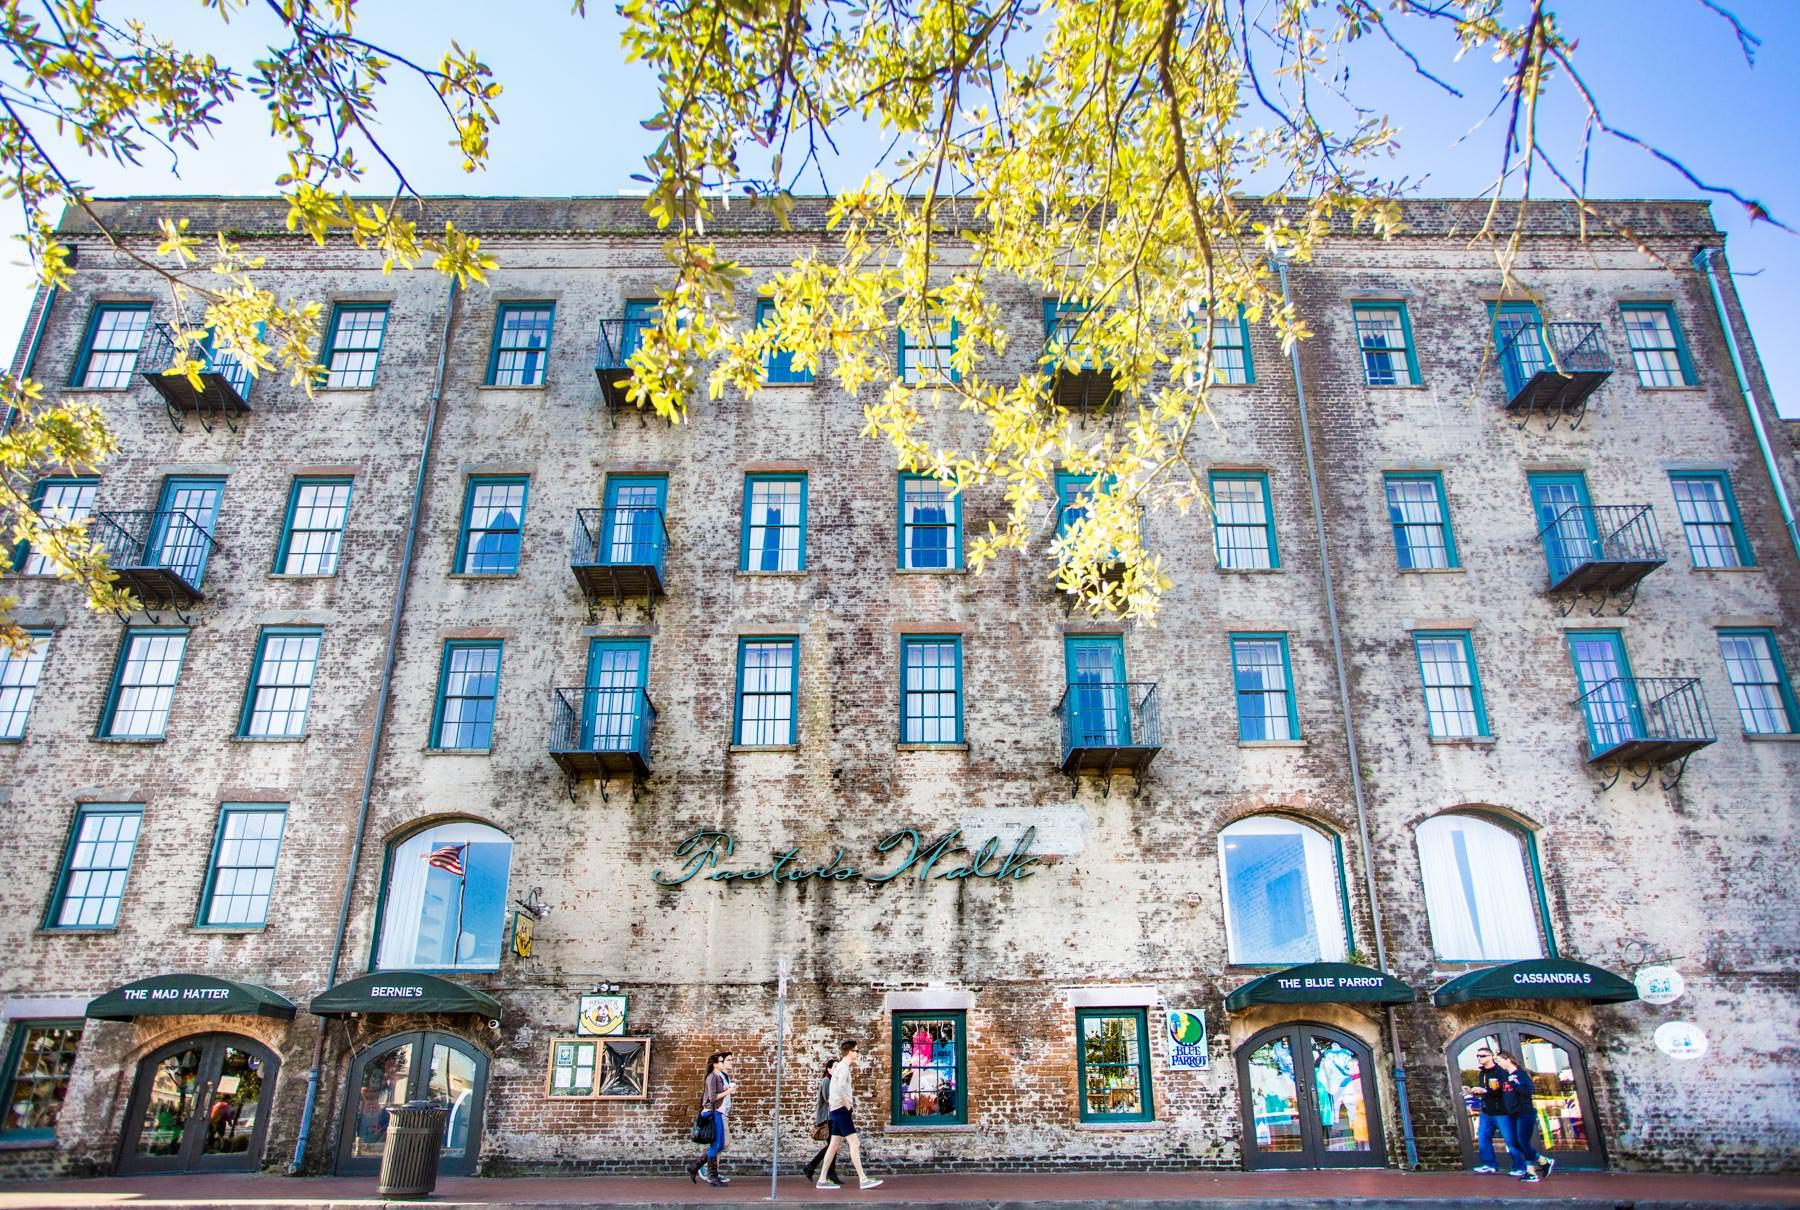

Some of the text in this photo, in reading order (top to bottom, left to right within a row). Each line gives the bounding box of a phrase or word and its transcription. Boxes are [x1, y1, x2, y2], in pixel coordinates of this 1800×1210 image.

[862, 825, 1041, 885] Walk
[1278, 977, 1384, 989] THE BLUE PARROT
[124, 989, 229, 1000] THE MAD HATTER
[371, 986, 423, 997] BERNIE'S
[1176, 1046, 1201, 1056] BLUE
[1171, 1055, 1208, 1068] PARROT
